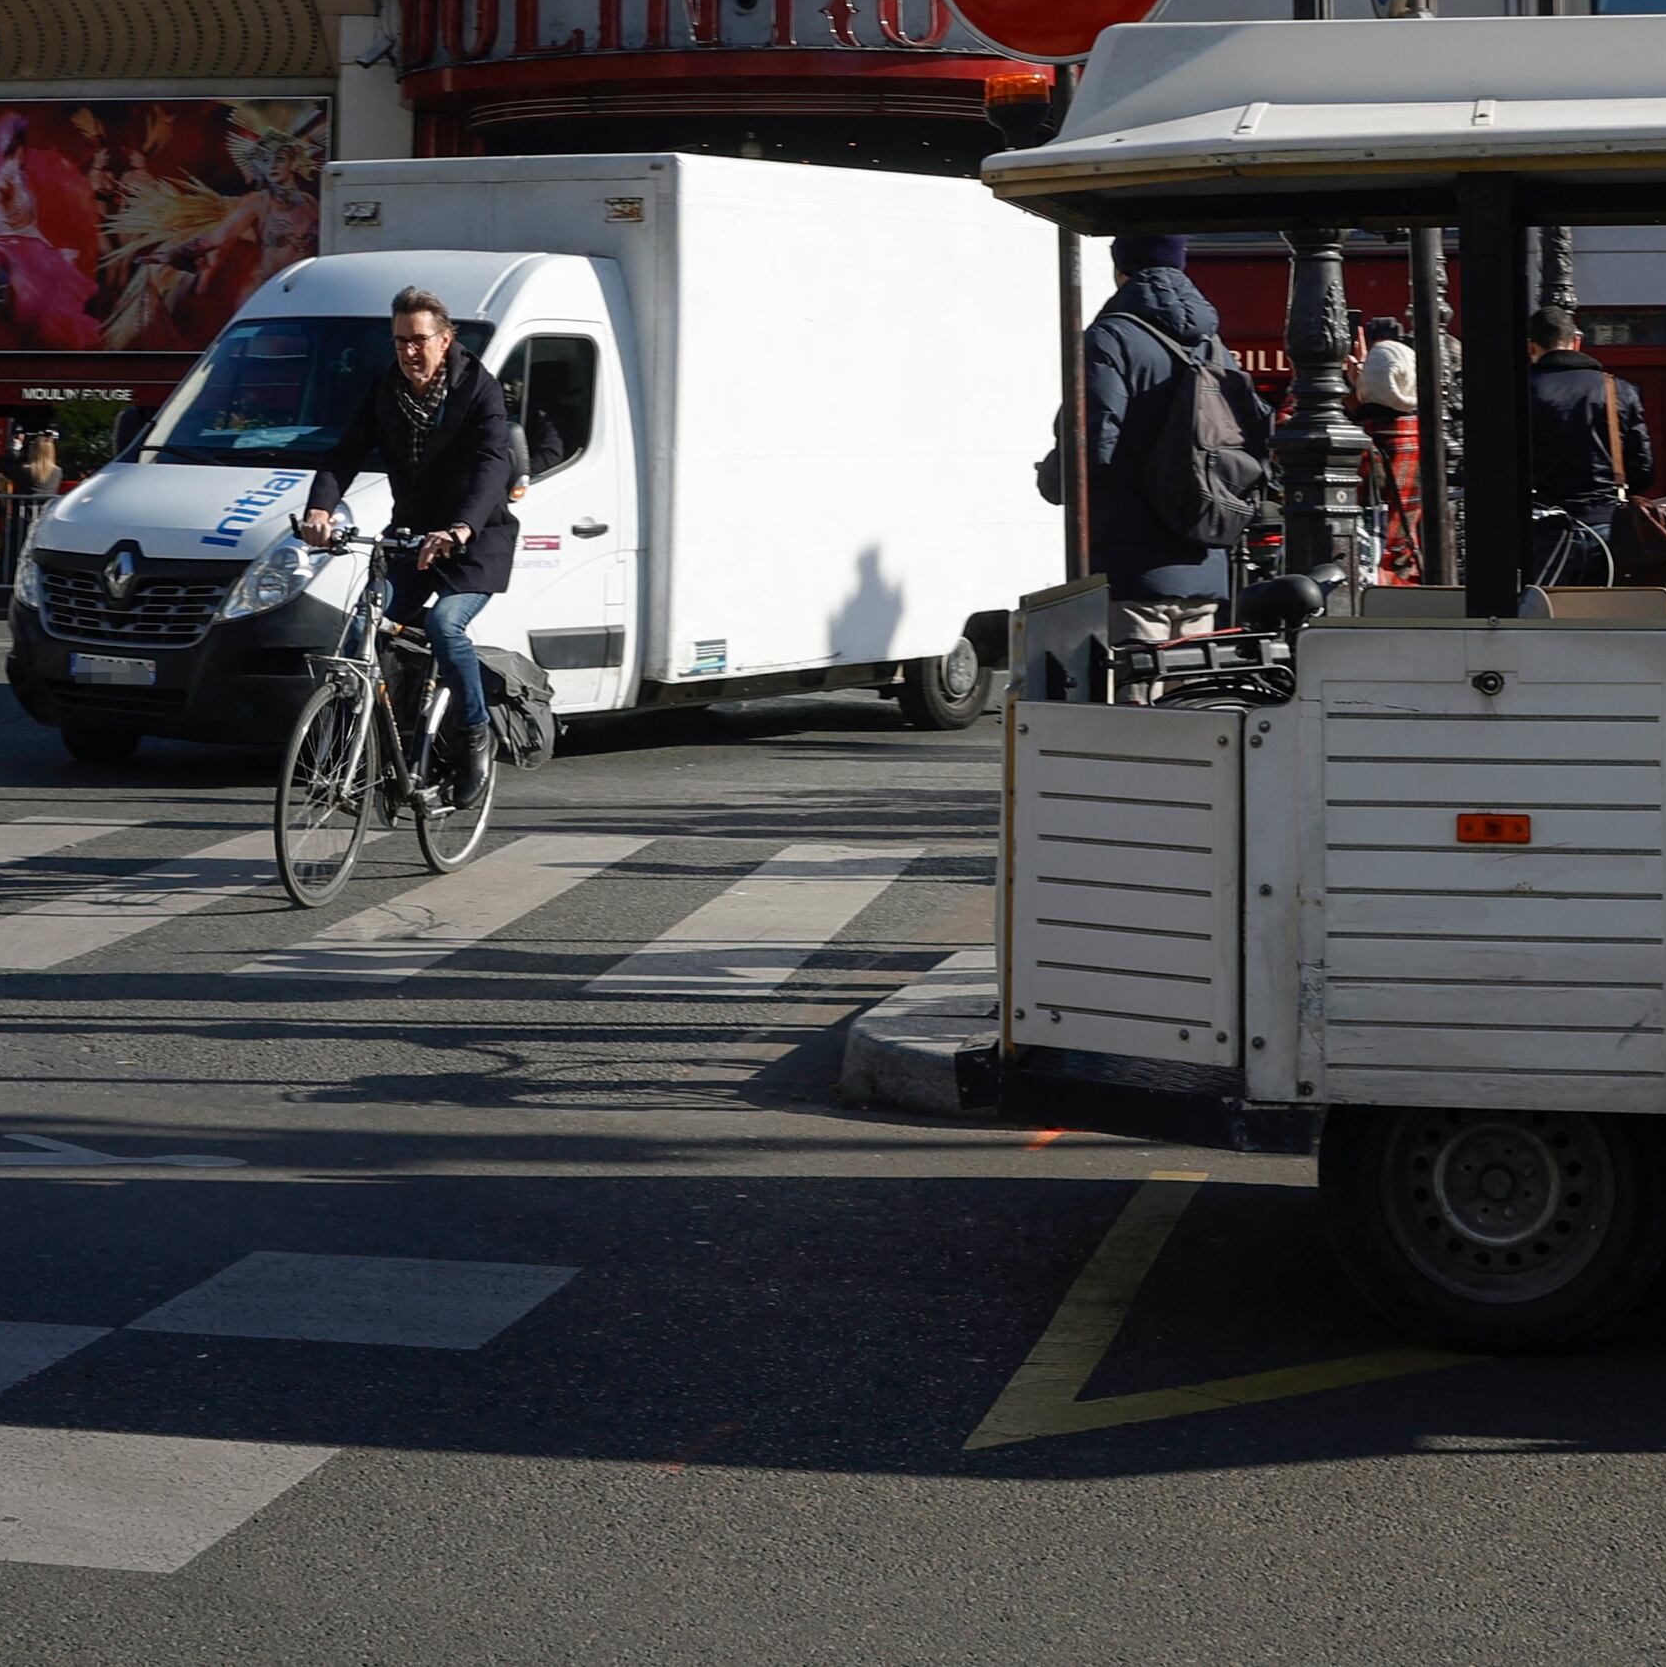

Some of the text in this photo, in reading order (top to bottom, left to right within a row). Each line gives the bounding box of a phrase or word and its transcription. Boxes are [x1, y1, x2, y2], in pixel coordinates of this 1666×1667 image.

[21, 388, 134, 401] MOULIN ROUGE
[199, 470, 308, 548] Initial
